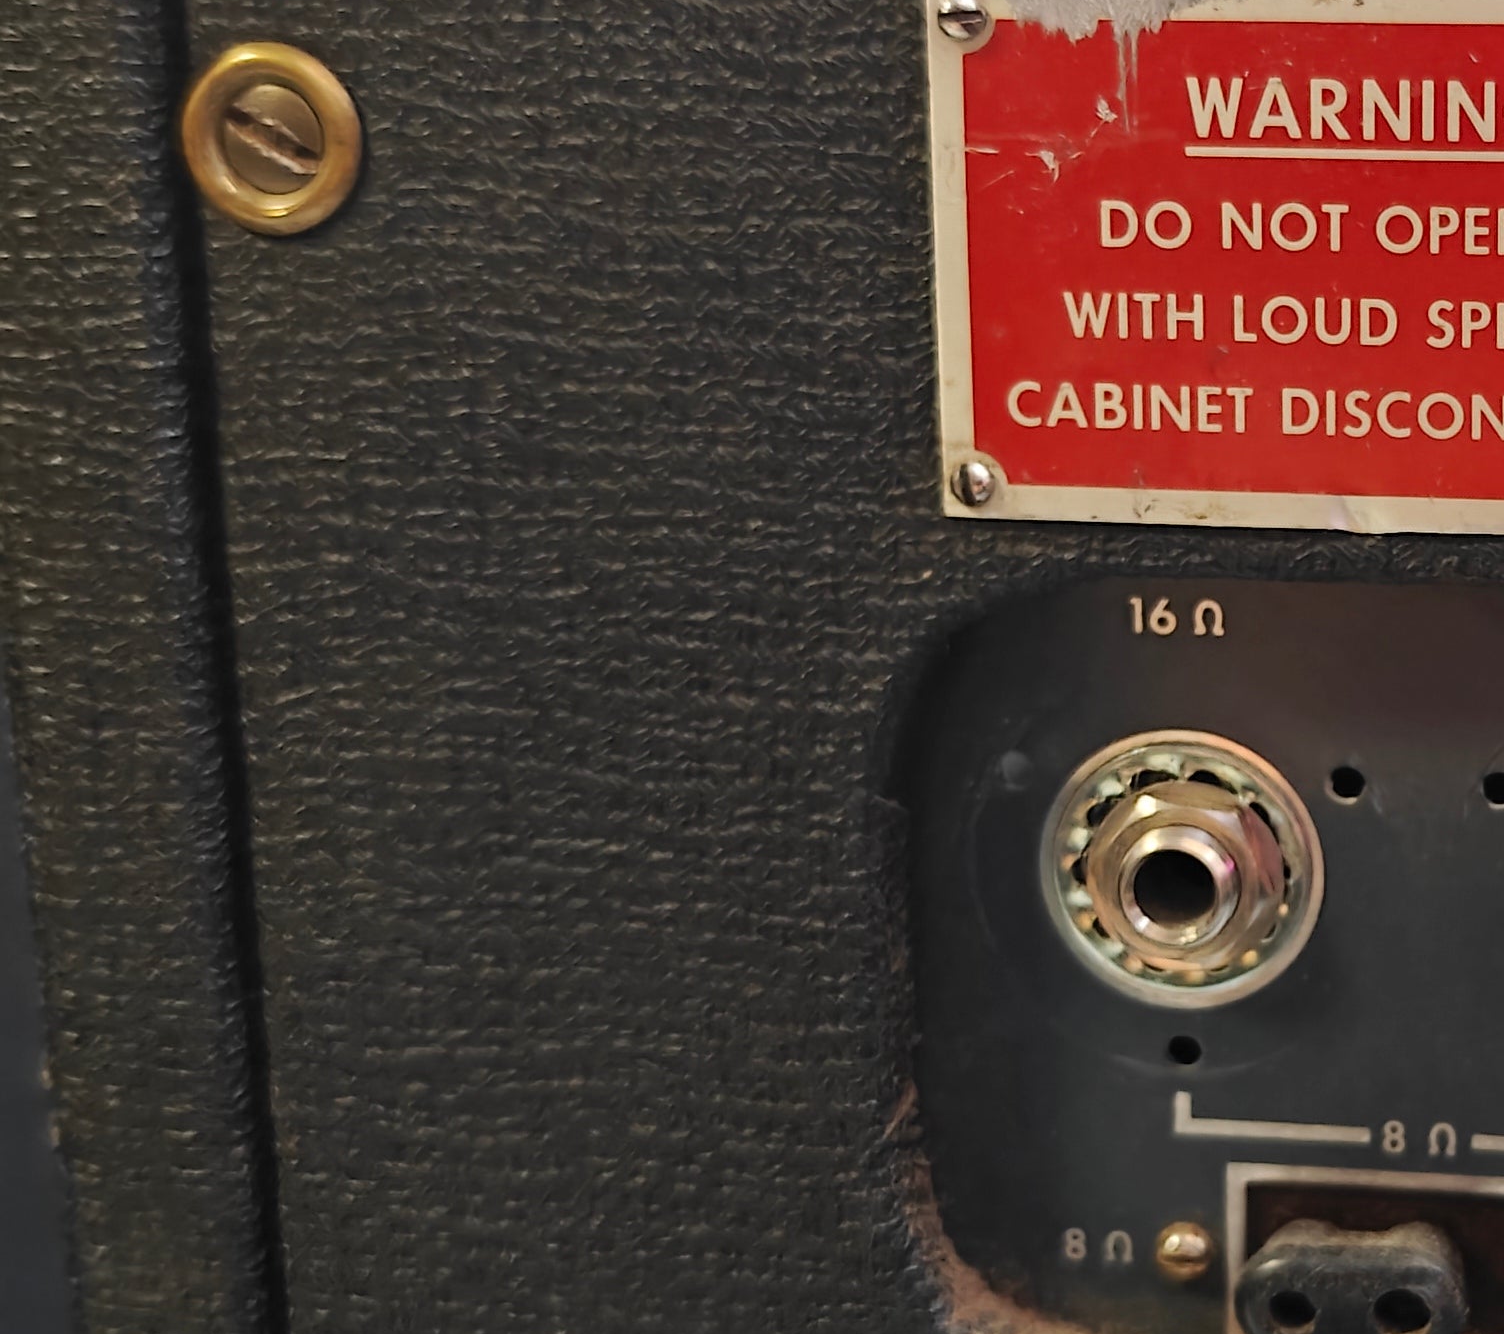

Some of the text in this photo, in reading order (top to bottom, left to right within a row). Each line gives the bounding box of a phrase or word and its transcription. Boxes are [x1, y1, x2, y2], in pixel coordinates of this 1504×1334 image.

[1100, 200, 1192, 249] DO
[1221, 202, 1349, 253] NOT
[1063, 291, 1204, 341] WITH
[1234, 295, 1397, 347] LOUD
[1006, 381, 1253, 435] CABINET
[1128, 597, 1226, 637] 16 Ω
[1382, 1121, 1458, 1158] 8 Ω
[1065, 1229, 1134, 1264] 8 Ω
